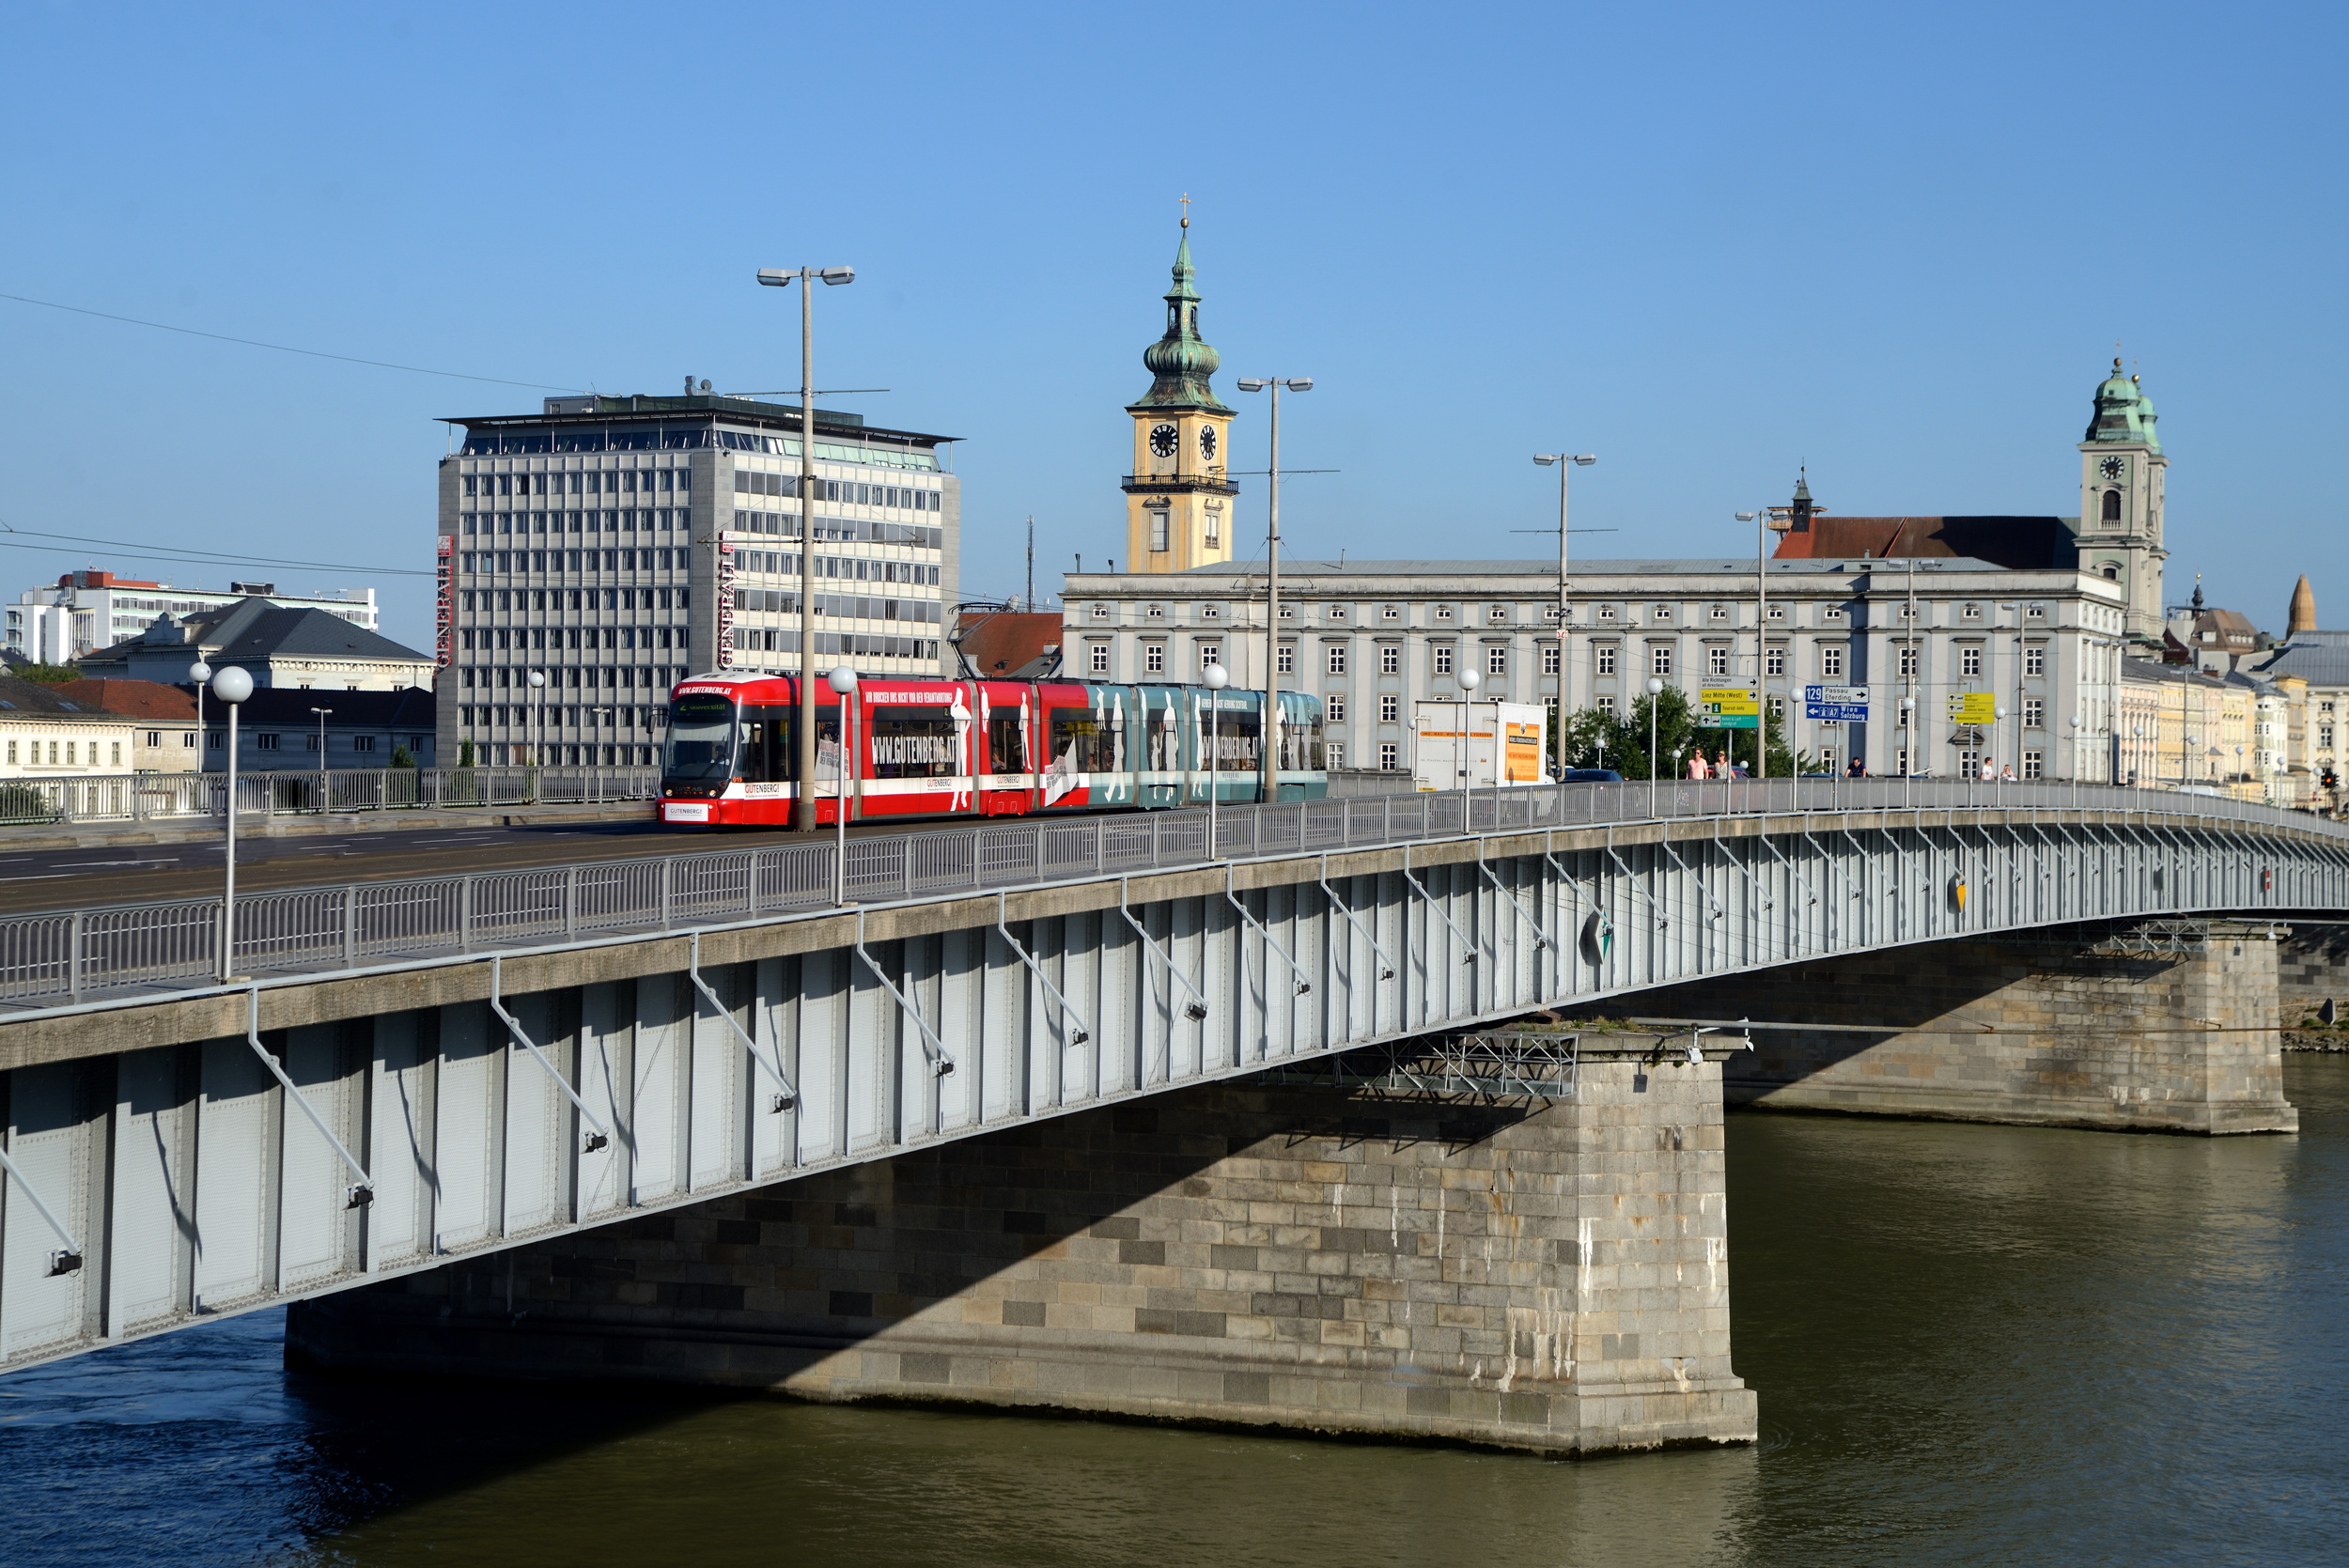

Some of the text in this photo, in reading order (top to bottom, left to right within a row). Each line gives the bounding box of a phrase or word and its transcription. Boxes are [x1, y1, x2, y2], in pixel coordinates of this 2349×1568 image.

[437, 564, 451, 668] GENERALI
[720, 560, 734, 668] GENERALI
[678, 686, 732, 695] WWW.GUTENBERG.AT
[1806, 688, 1822, 701] 129
[898, 692, 908, 703] NICHT
[1825, 694, 1852, 703] Eferding
[944, 707, 949, 717] 2
[1829, 708, 1838, 717] A7
[1841, 712, 1865, 721] Salzburg
[871, 736, 956, 765] WWW.GUTENBERG.AT
[927, 779, 952, 787] GUTENBERG!
[745, 784, 780, 794] GUTENBERG!
